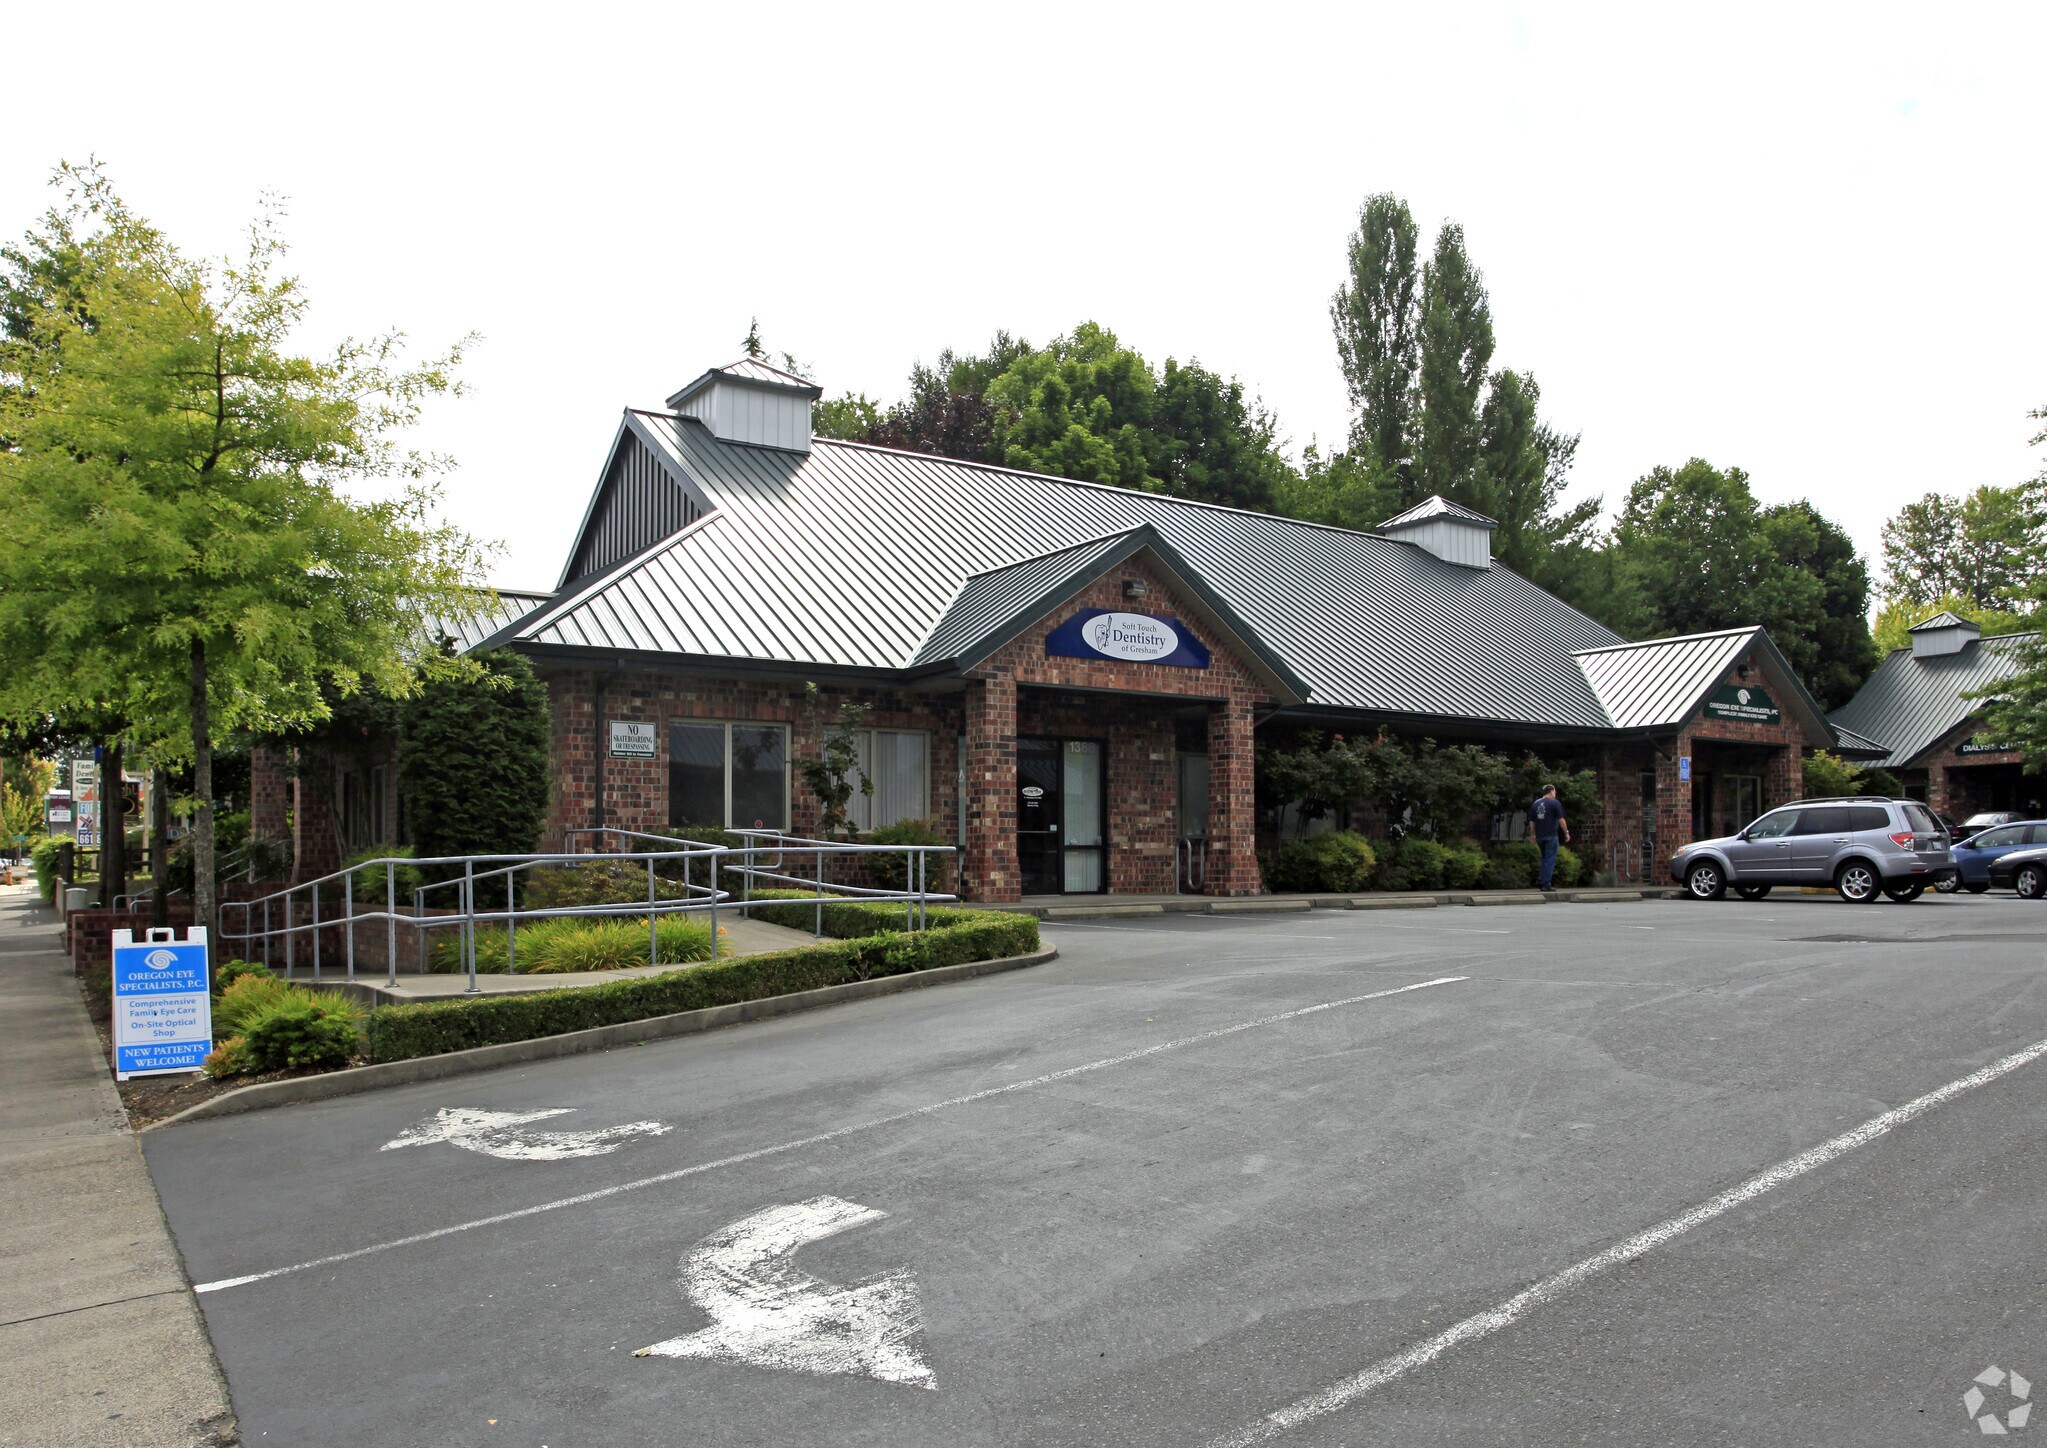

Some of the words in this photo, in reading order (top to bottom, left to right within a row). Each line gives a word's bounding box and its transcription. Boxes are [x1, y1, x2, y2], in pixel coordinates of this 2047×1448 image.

[1122, 622, 1136, 630] Soft
[1137, 623, 1157, 632] Touch
[1113, 629, 1166, 650] Dentistry
[1130, 646, 1158, 654] Gresham
[628, 725, 638, 735] NO
[614, 735, 652, 743] SKATEBOARDING
[128, 971, 174, 980] OREGON
[176, 970, 195, 978] EYE
[119, 981, 185, 991] SPECIALISTS,
[129, 998, 196, 1008] Comprehensive
[130, 1008, 159, 1018] Family
[160, 1008, 175, 1016] Eye
[131, 1021, 164, 1029] On-Site
[165, 1018, 196, 1028] Optical
[153, 1029, 176, 1037] Shop
[125, 1048, 152, 1057] NEW
[154, 1044, 205, 1056] PATIENTS
[135, 1056, 196, 1067] WELCOME!
